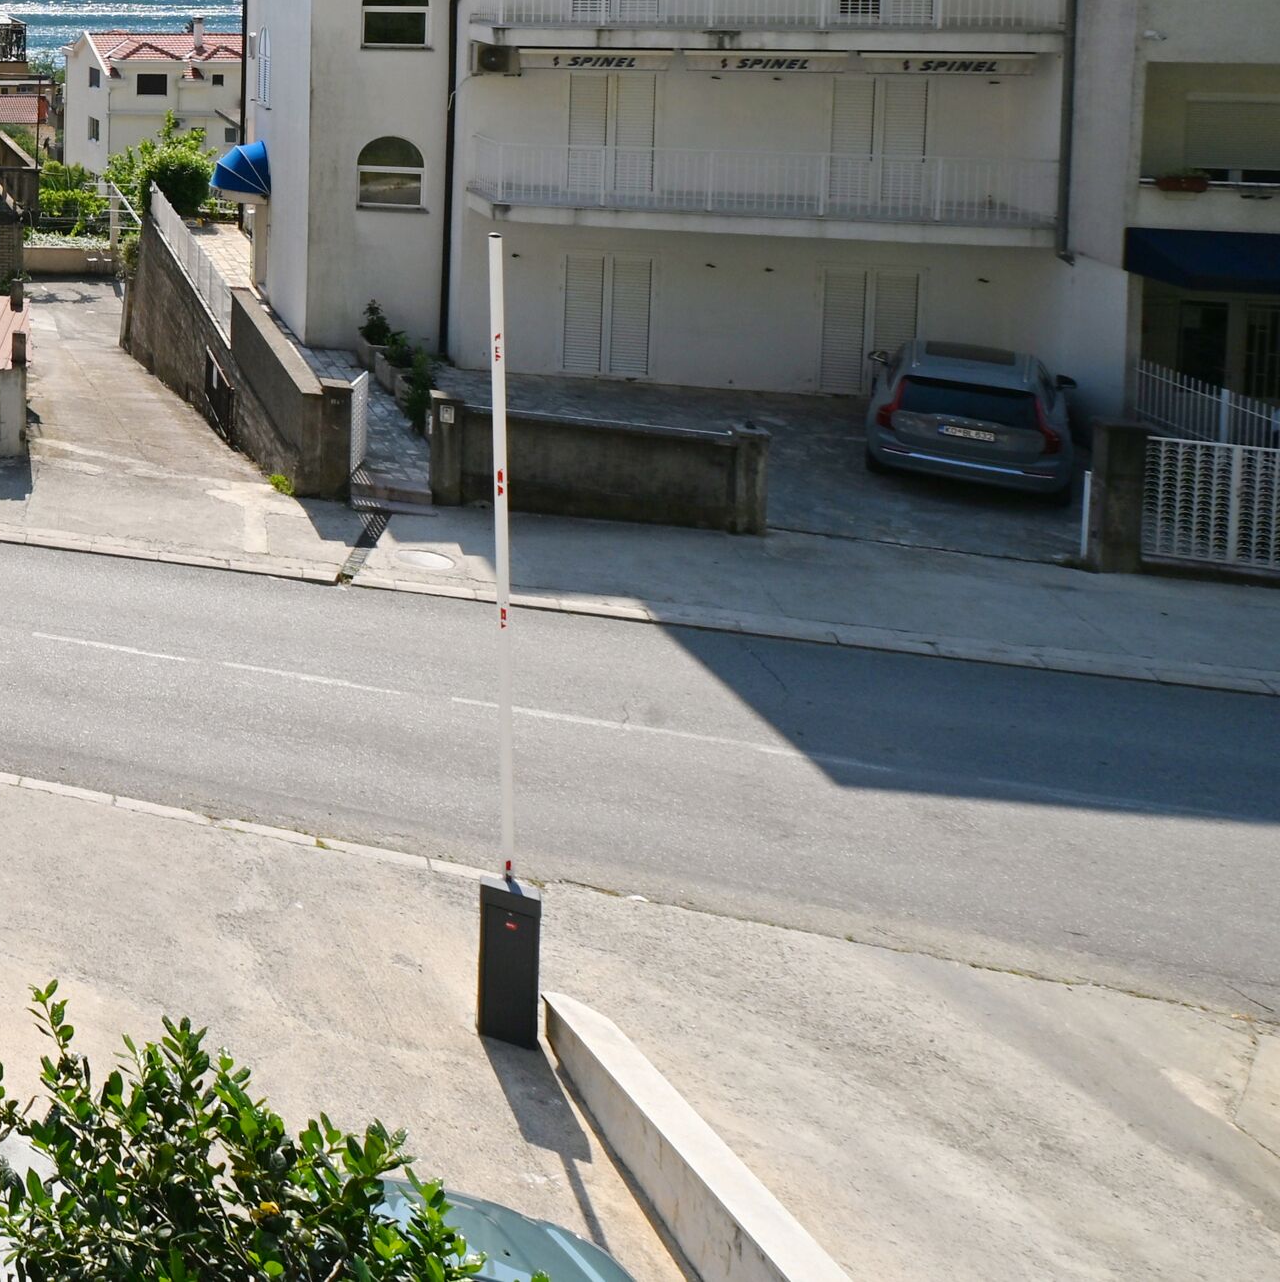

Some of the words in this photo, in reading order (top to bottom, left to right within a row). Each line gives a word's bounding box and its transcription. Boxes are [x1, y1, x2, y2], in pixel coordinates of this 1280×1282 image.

[567, 56, 637, 68] SPINEL
[736, 58, 809, 70] SPINEL
[919, 60, 998, 72] SPINEL
